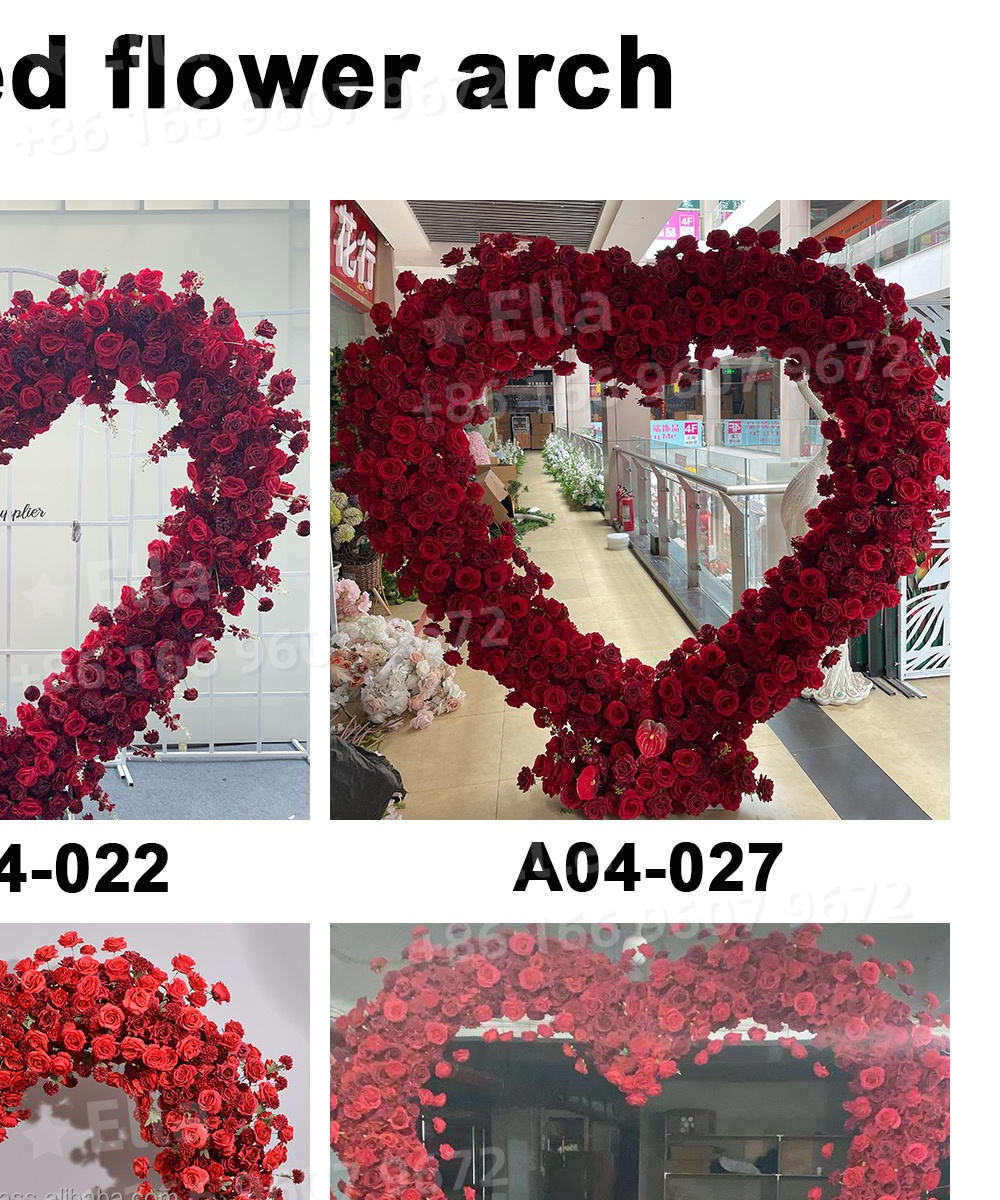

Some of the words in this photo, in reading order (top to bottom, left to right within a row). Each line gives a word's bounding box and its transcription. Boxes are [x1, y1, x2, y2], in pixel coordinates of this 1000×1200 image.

[681, 217, 693, 226] 4F
[334, 204, 377, 290] 花行
[685, 424, 698, 434] 4F
